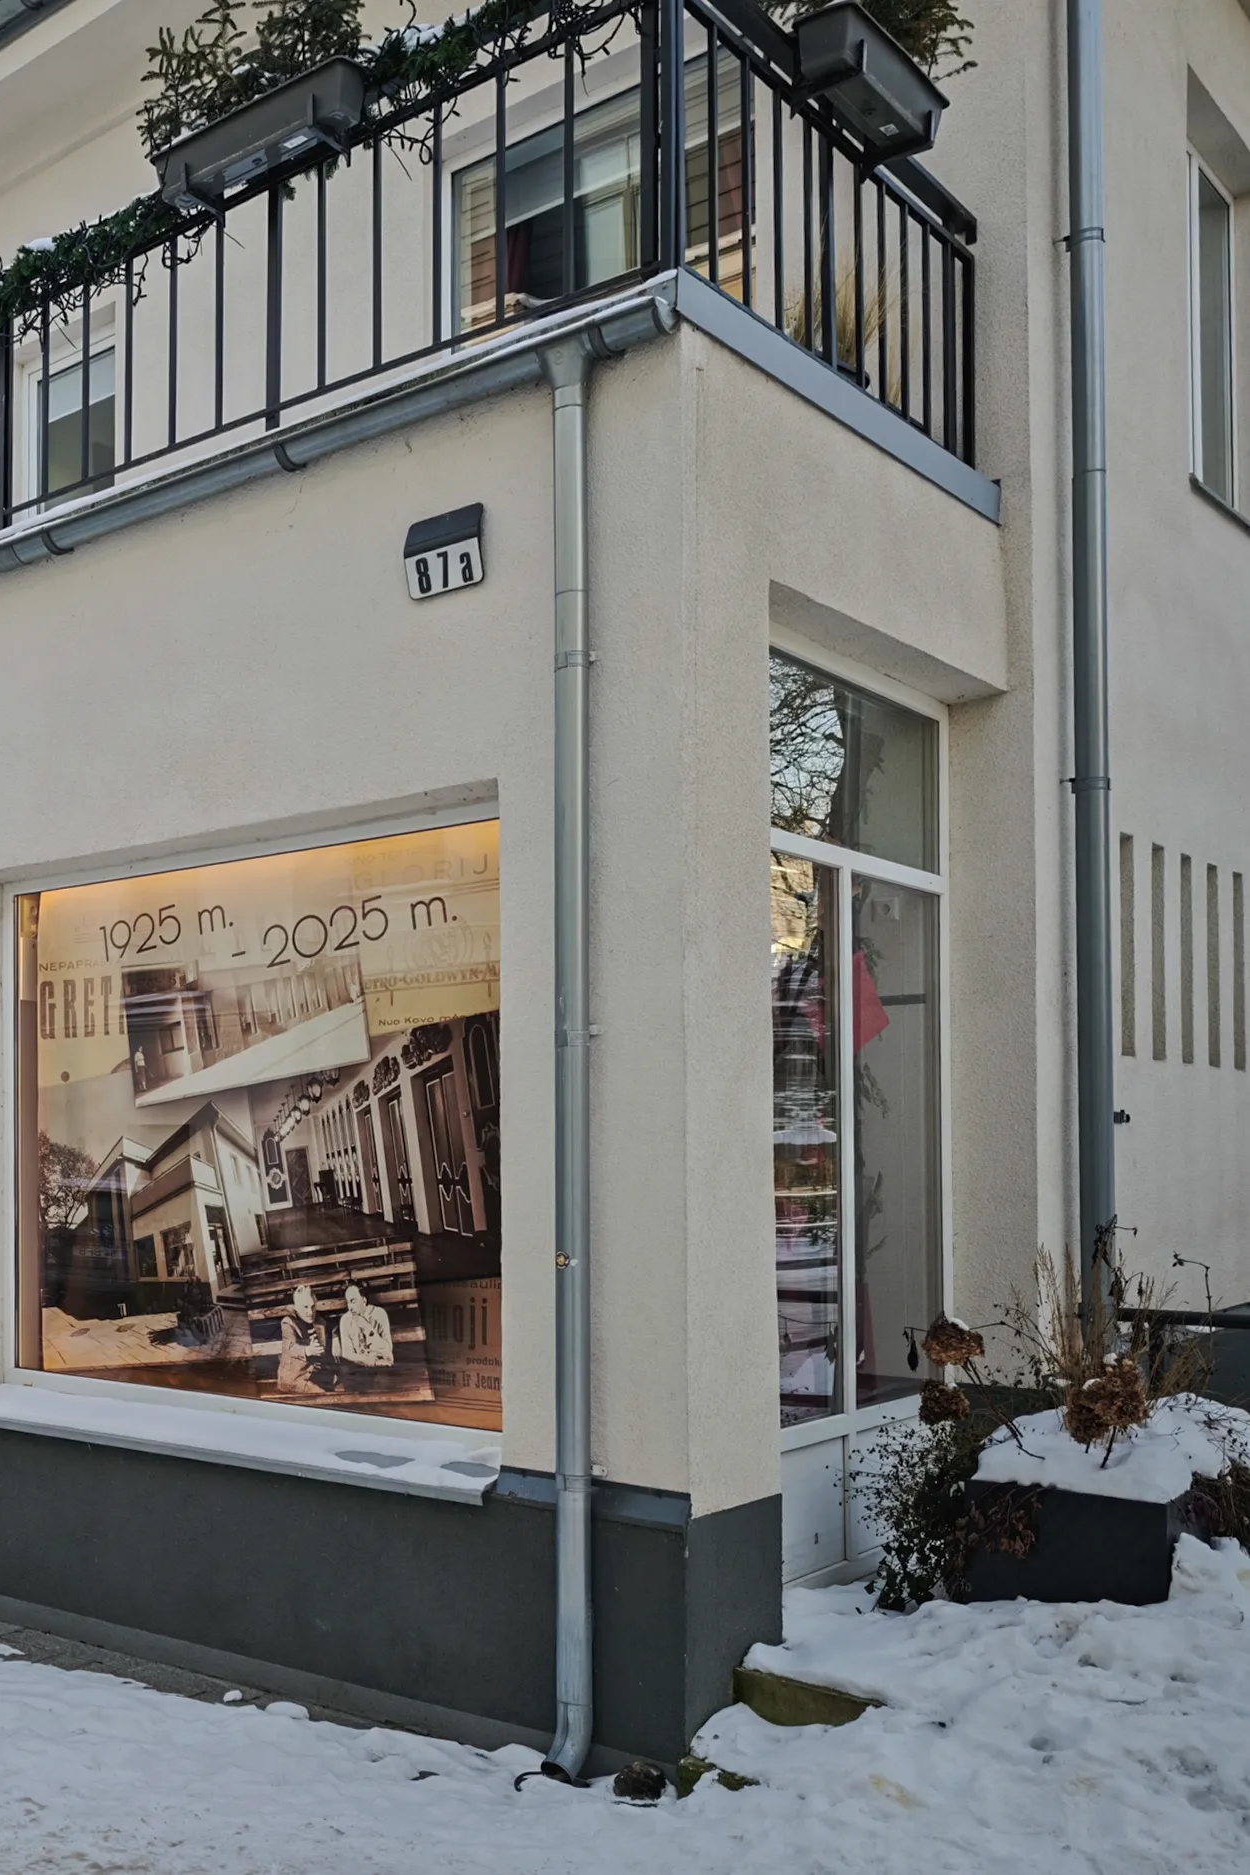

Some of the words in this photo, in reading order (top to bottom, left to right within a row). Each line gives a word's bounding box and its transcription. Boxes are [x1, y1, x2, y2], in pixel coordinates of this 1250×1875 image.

[415, 550, 474, 594] 87a
[354, 853, 499, 891] GLORIJ
[99, 904, 181, 962] 1925
[197, 905, 234, 935] m.
[263, 895, 389, 968] 2025
[410, 896, 458, 930] m.
[39, 975, 126, 1041] GRET
[378, 1018, 401, 1028] Nuo
[404, 1015, 435, 1025] Kovo
